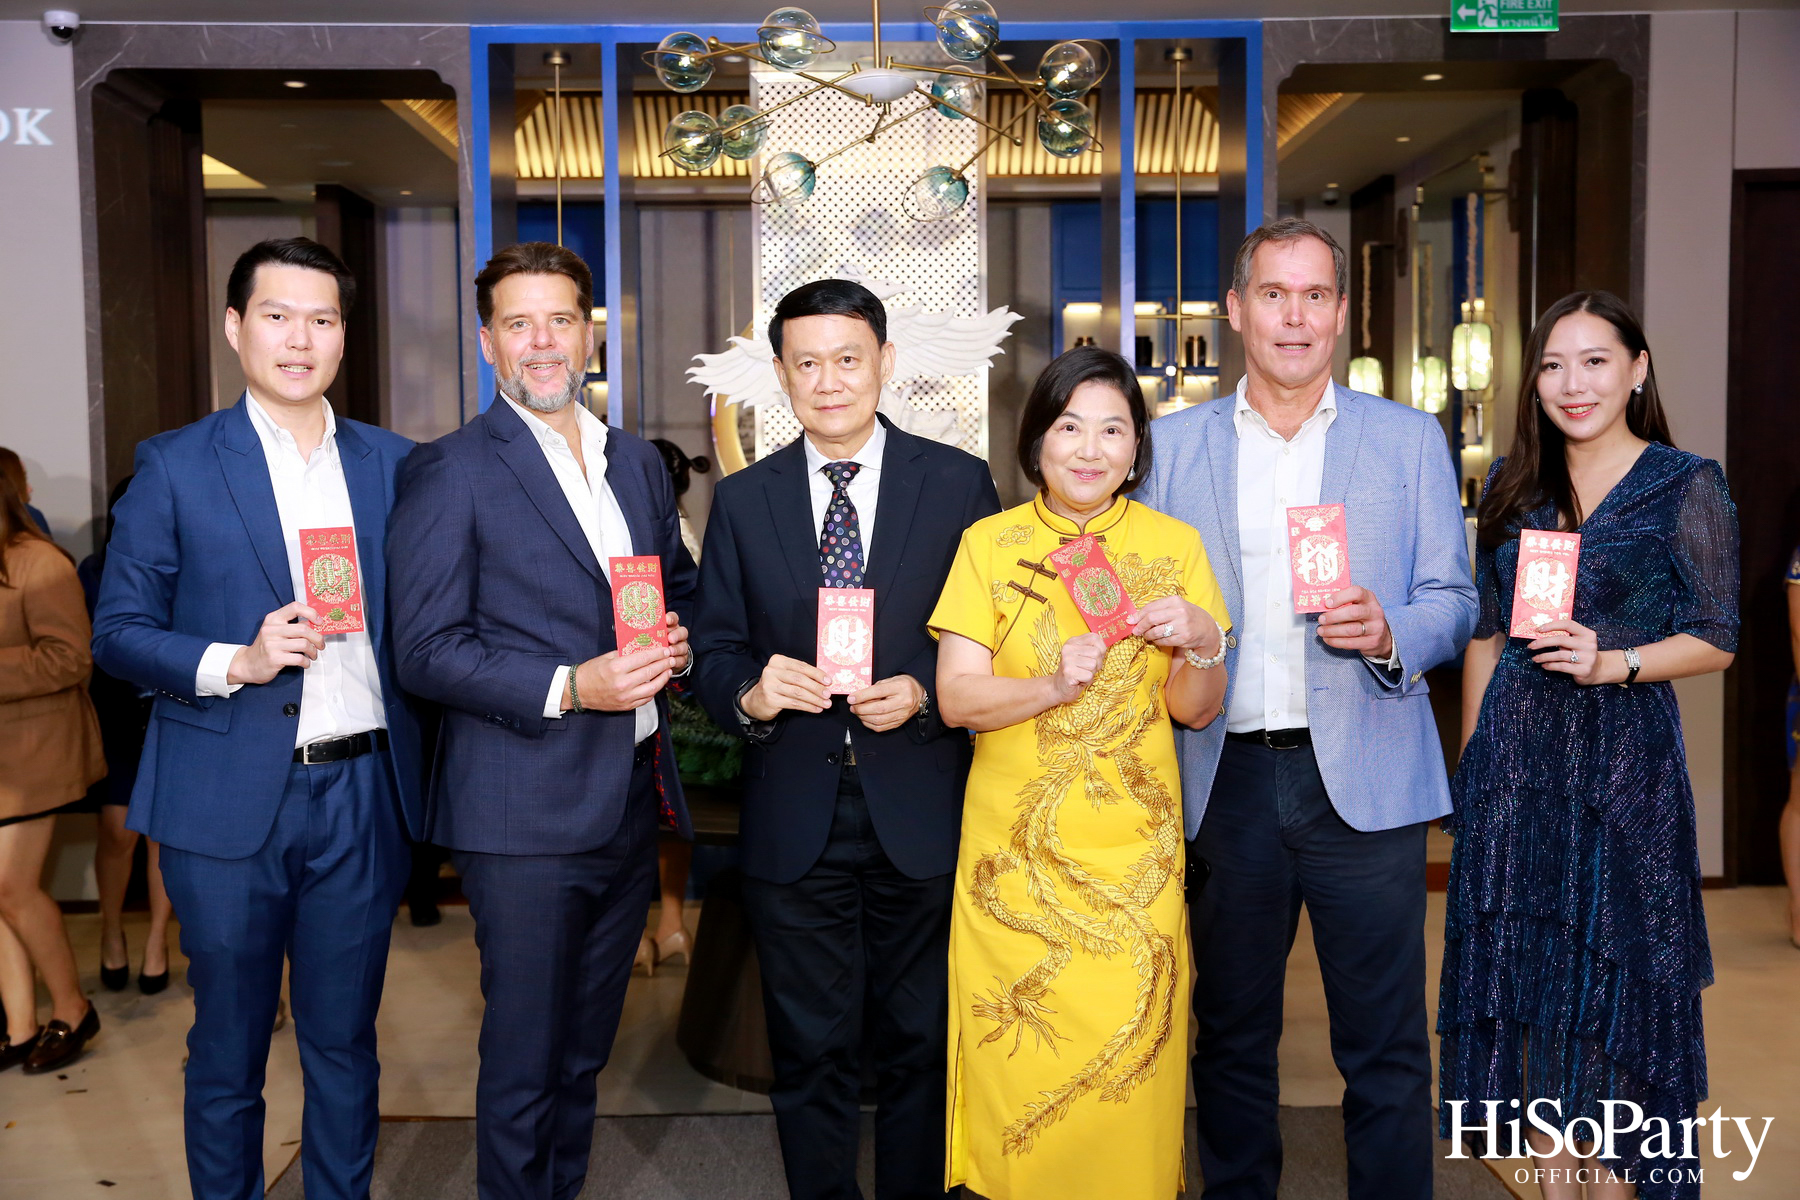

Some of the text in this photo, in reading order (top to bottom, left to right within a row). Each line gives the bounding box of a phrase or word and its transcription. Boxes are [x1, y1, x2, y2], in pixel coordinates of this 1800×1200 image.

[1500, 0, 1553, 9] FIRE EXIT
[1521, 560, 1570, 609] 財
[823, 618, 869, 663] 財
